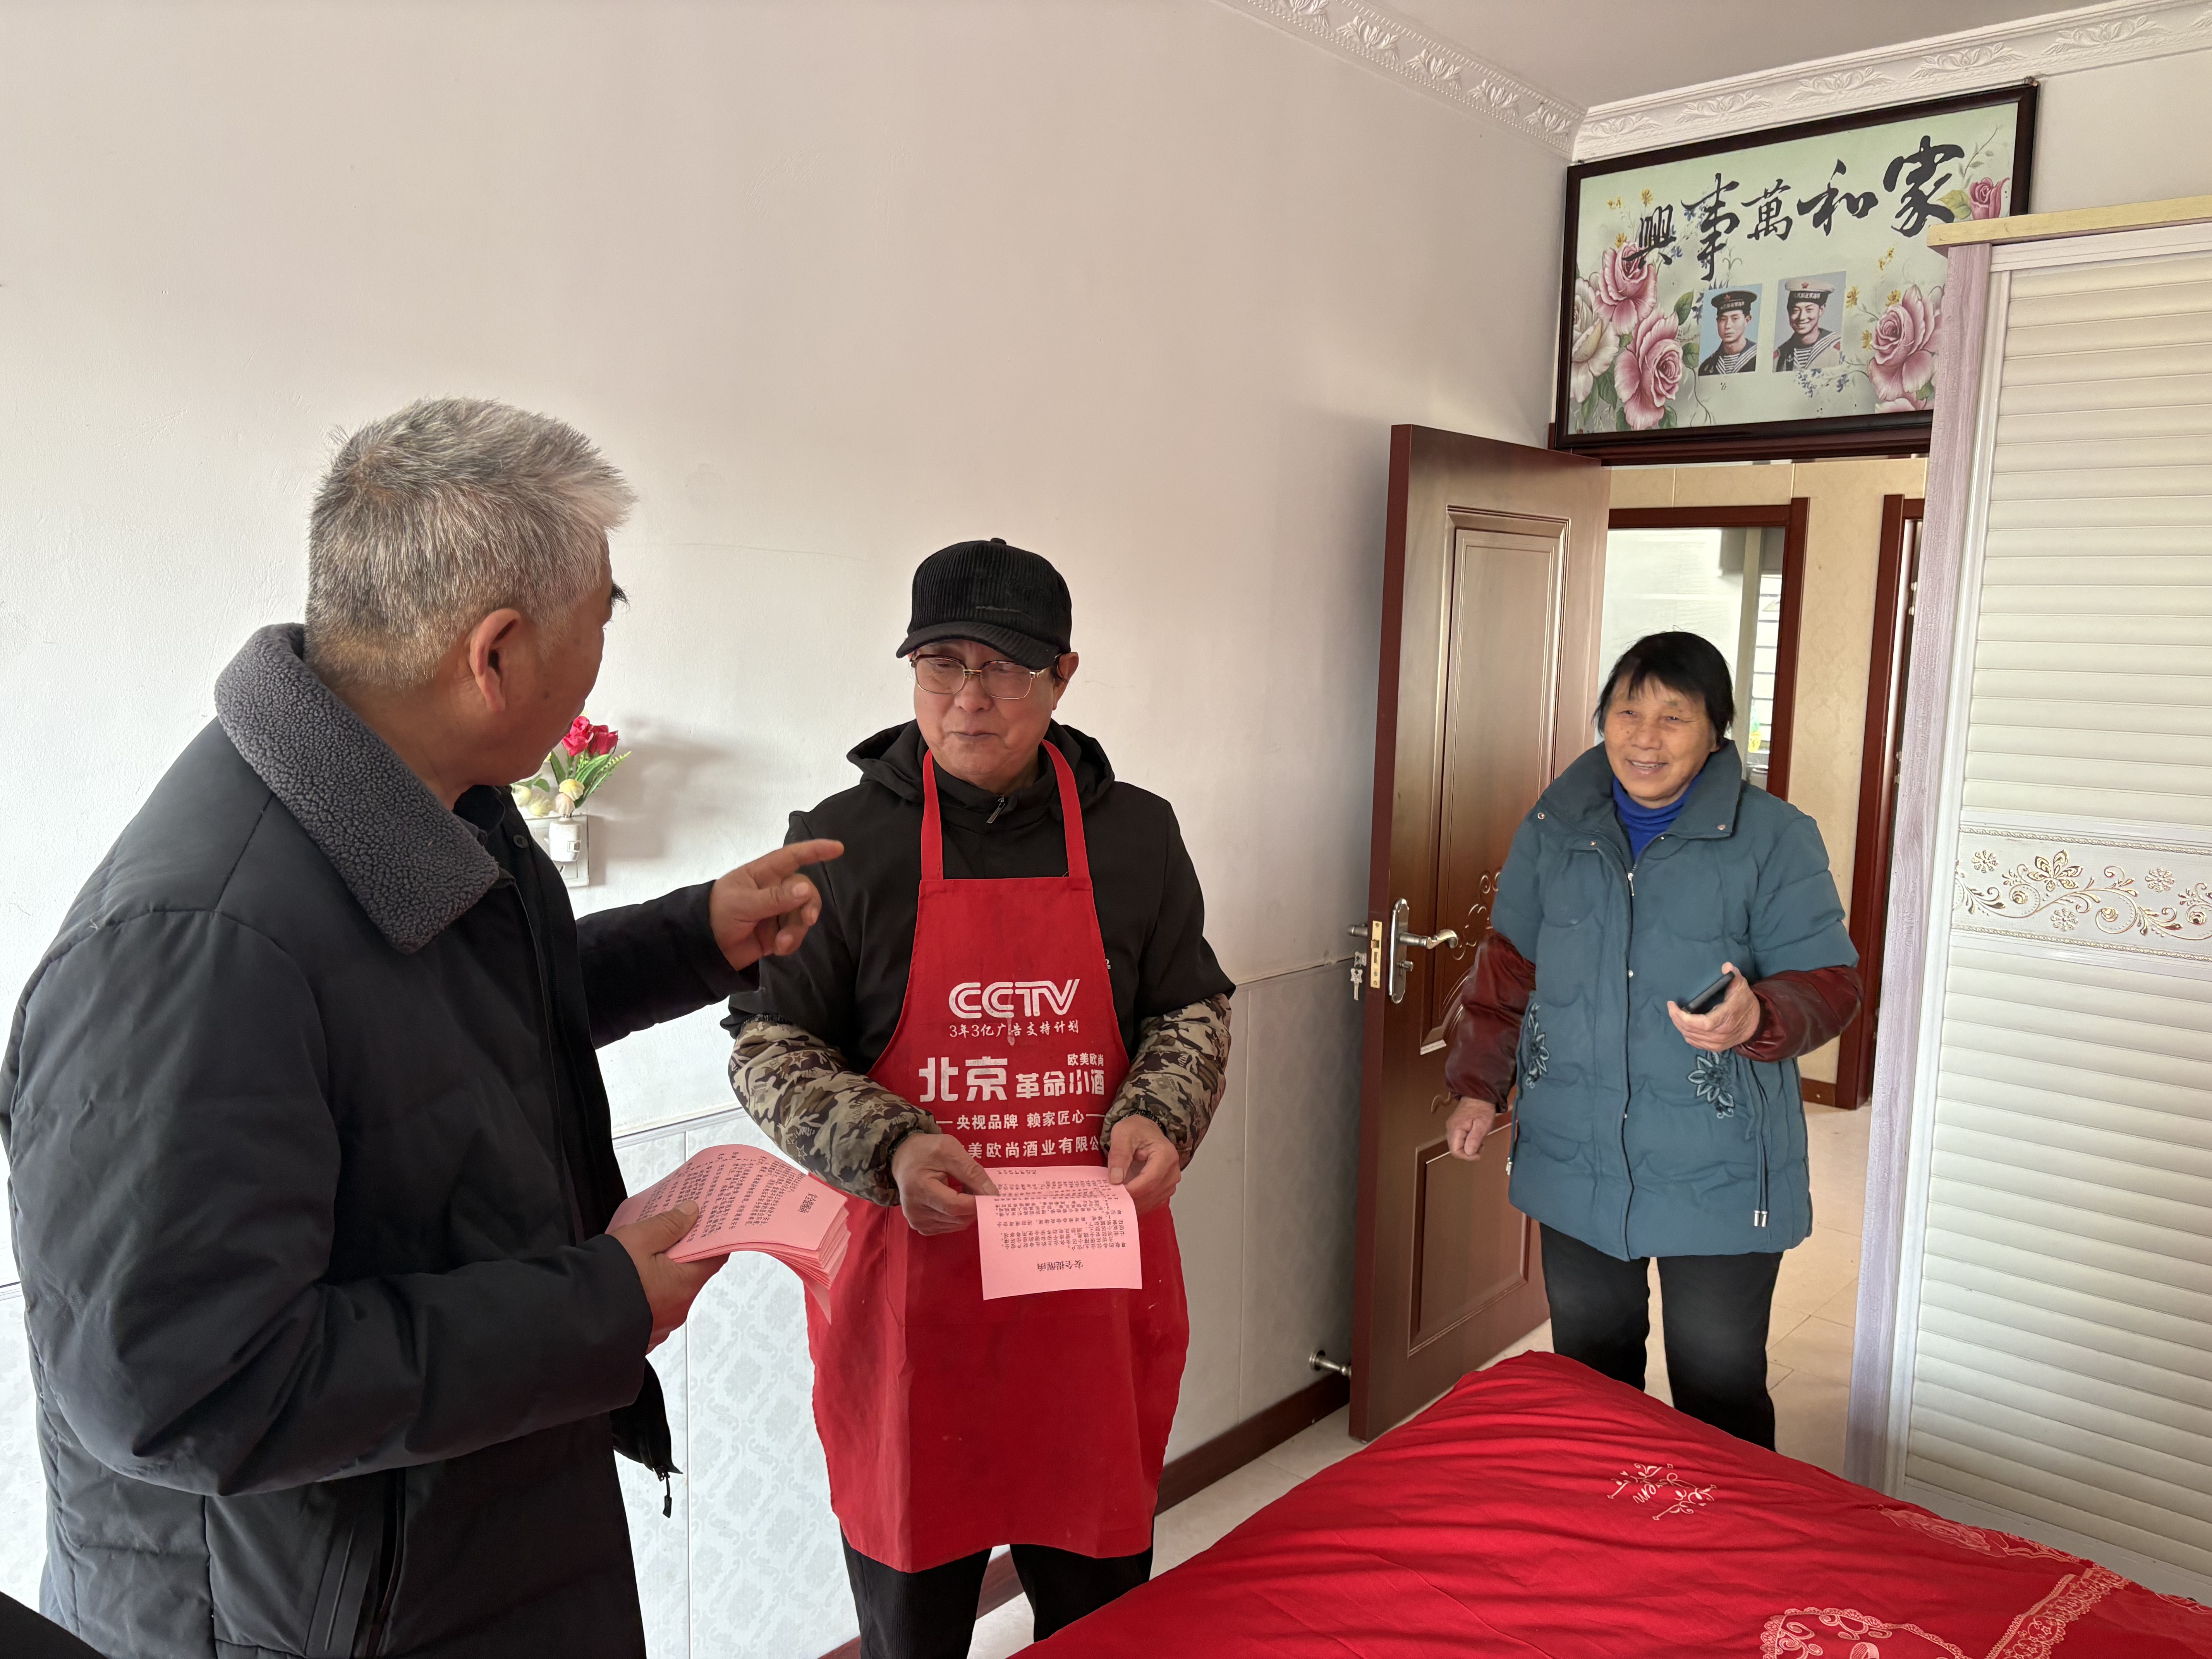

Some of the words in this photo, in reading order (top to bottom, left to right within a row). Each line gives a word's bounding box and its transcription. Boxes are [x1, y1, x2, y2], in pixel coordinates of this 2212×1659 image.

[949, 979, 1080, 1018] CCTV
[950, 1019, 1079, 1039] 3年3亿广告支持计划
[1067, 1053, 1104, 1066] 欧美欧尚
[919, 1056, 1008, 1102] 北京
[1016, 1069, 1104, 1099] 革命小酒
[957, 1114, 1018, 1130] 央视品牌
[1027, 1109, 1084, 1128] 赖家匠心
